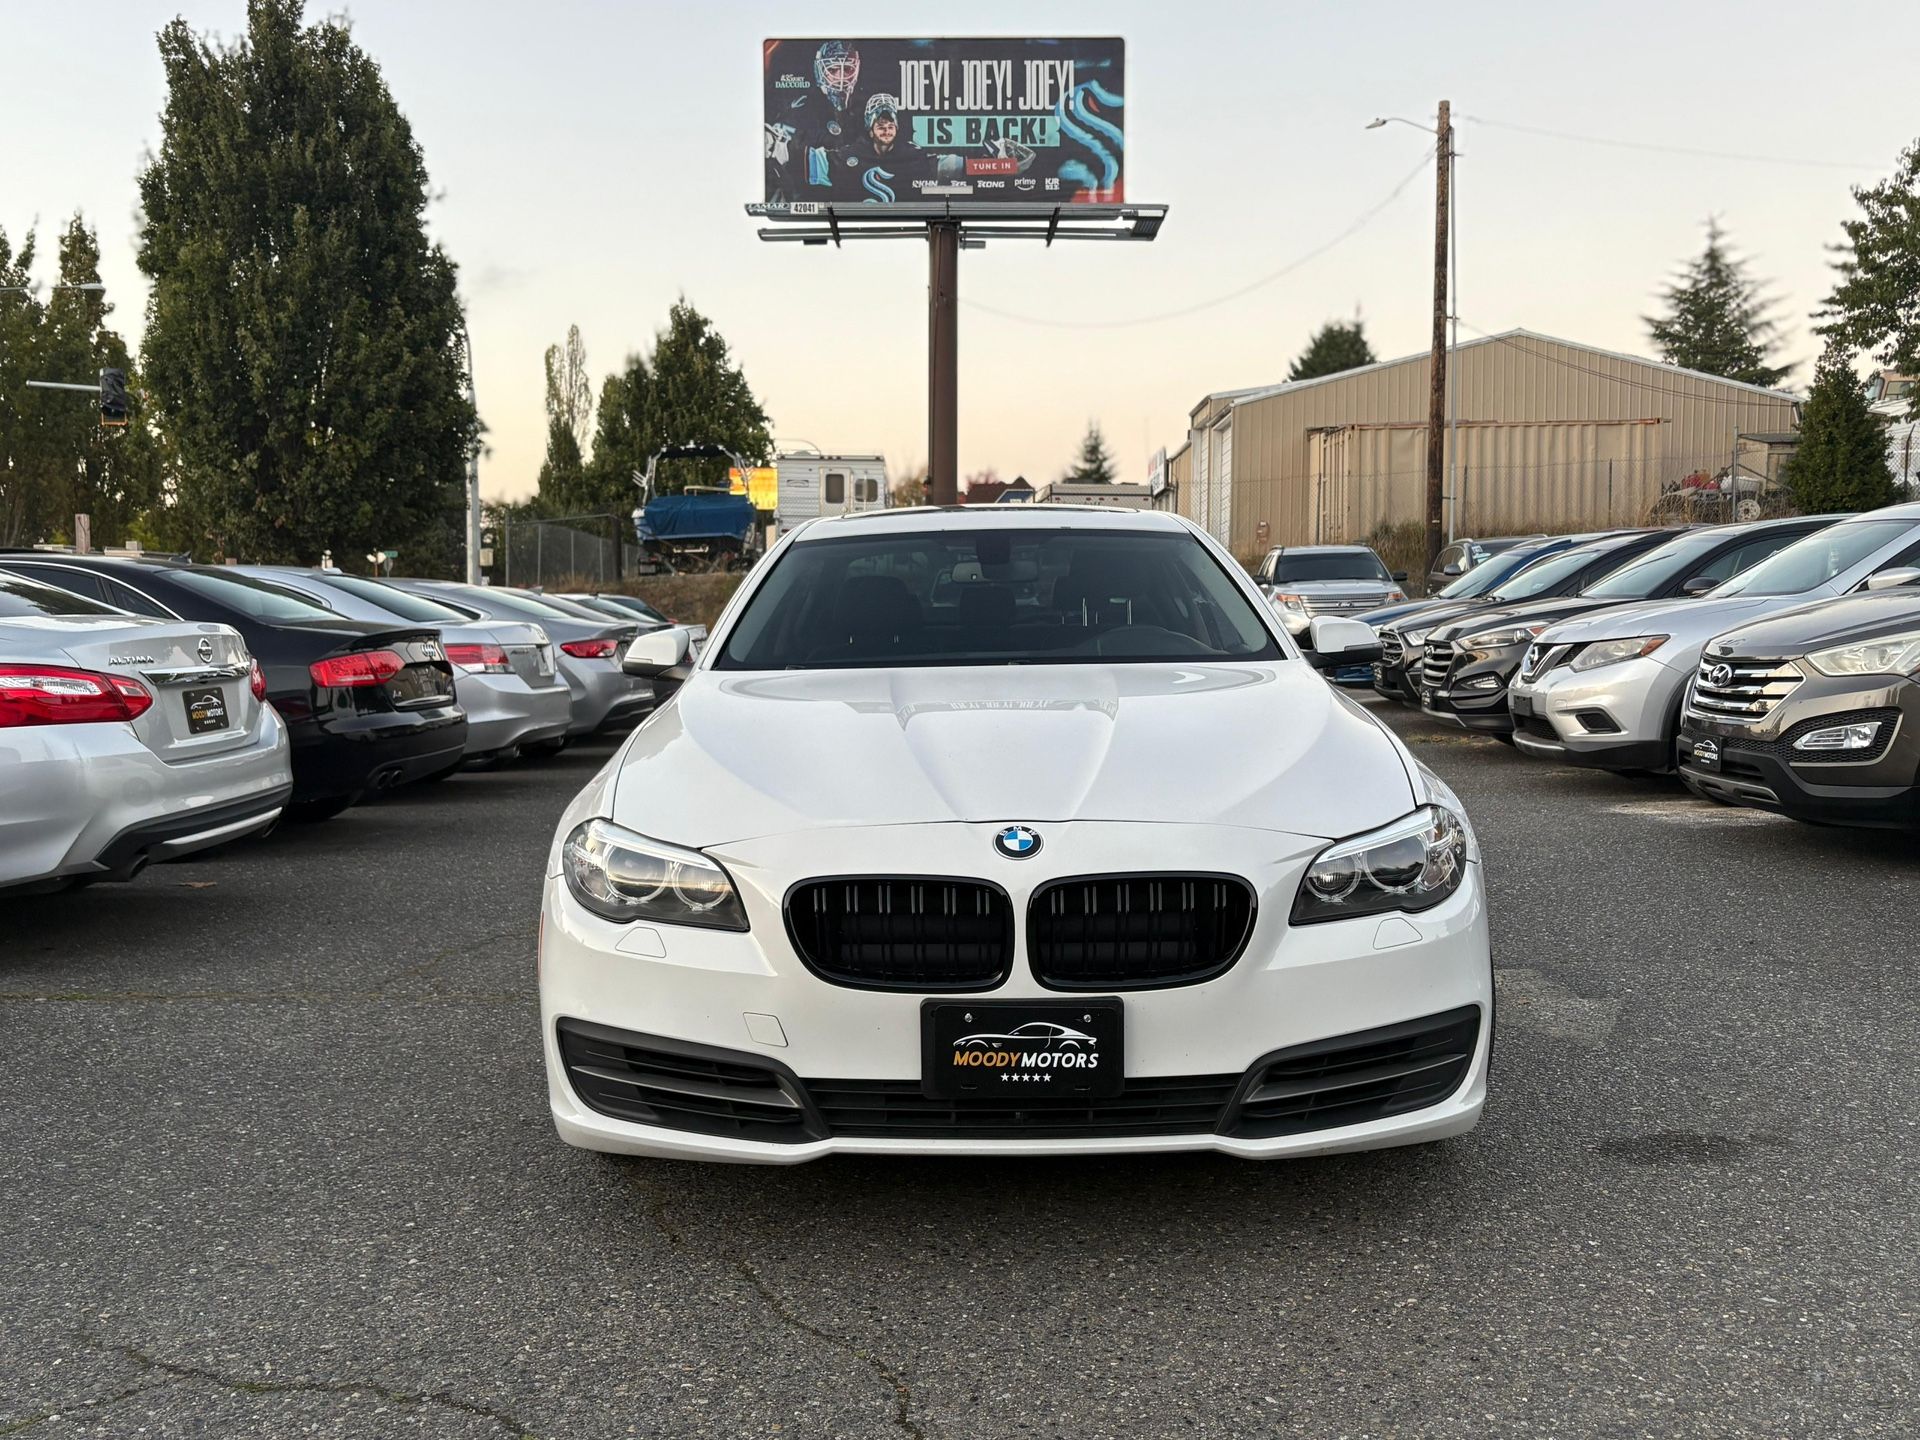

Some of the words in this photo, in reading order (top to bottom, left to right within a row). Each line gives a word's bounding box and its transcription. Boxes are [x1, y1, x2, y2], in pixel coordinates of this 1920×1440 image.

[895, 60, 950, 110] JOEY!
[956, 60, 1012, 110] JOEY!
[1018, 60, 1074, 110] JOEY!
[927, 118, 952, 145] IS
[966, 117, 1046, 145] BACK!
[1014, 177, 1036, 186] prime
[793, 203, 816, 213] 42041
[108, 655, 154, 666] ALTIMA
